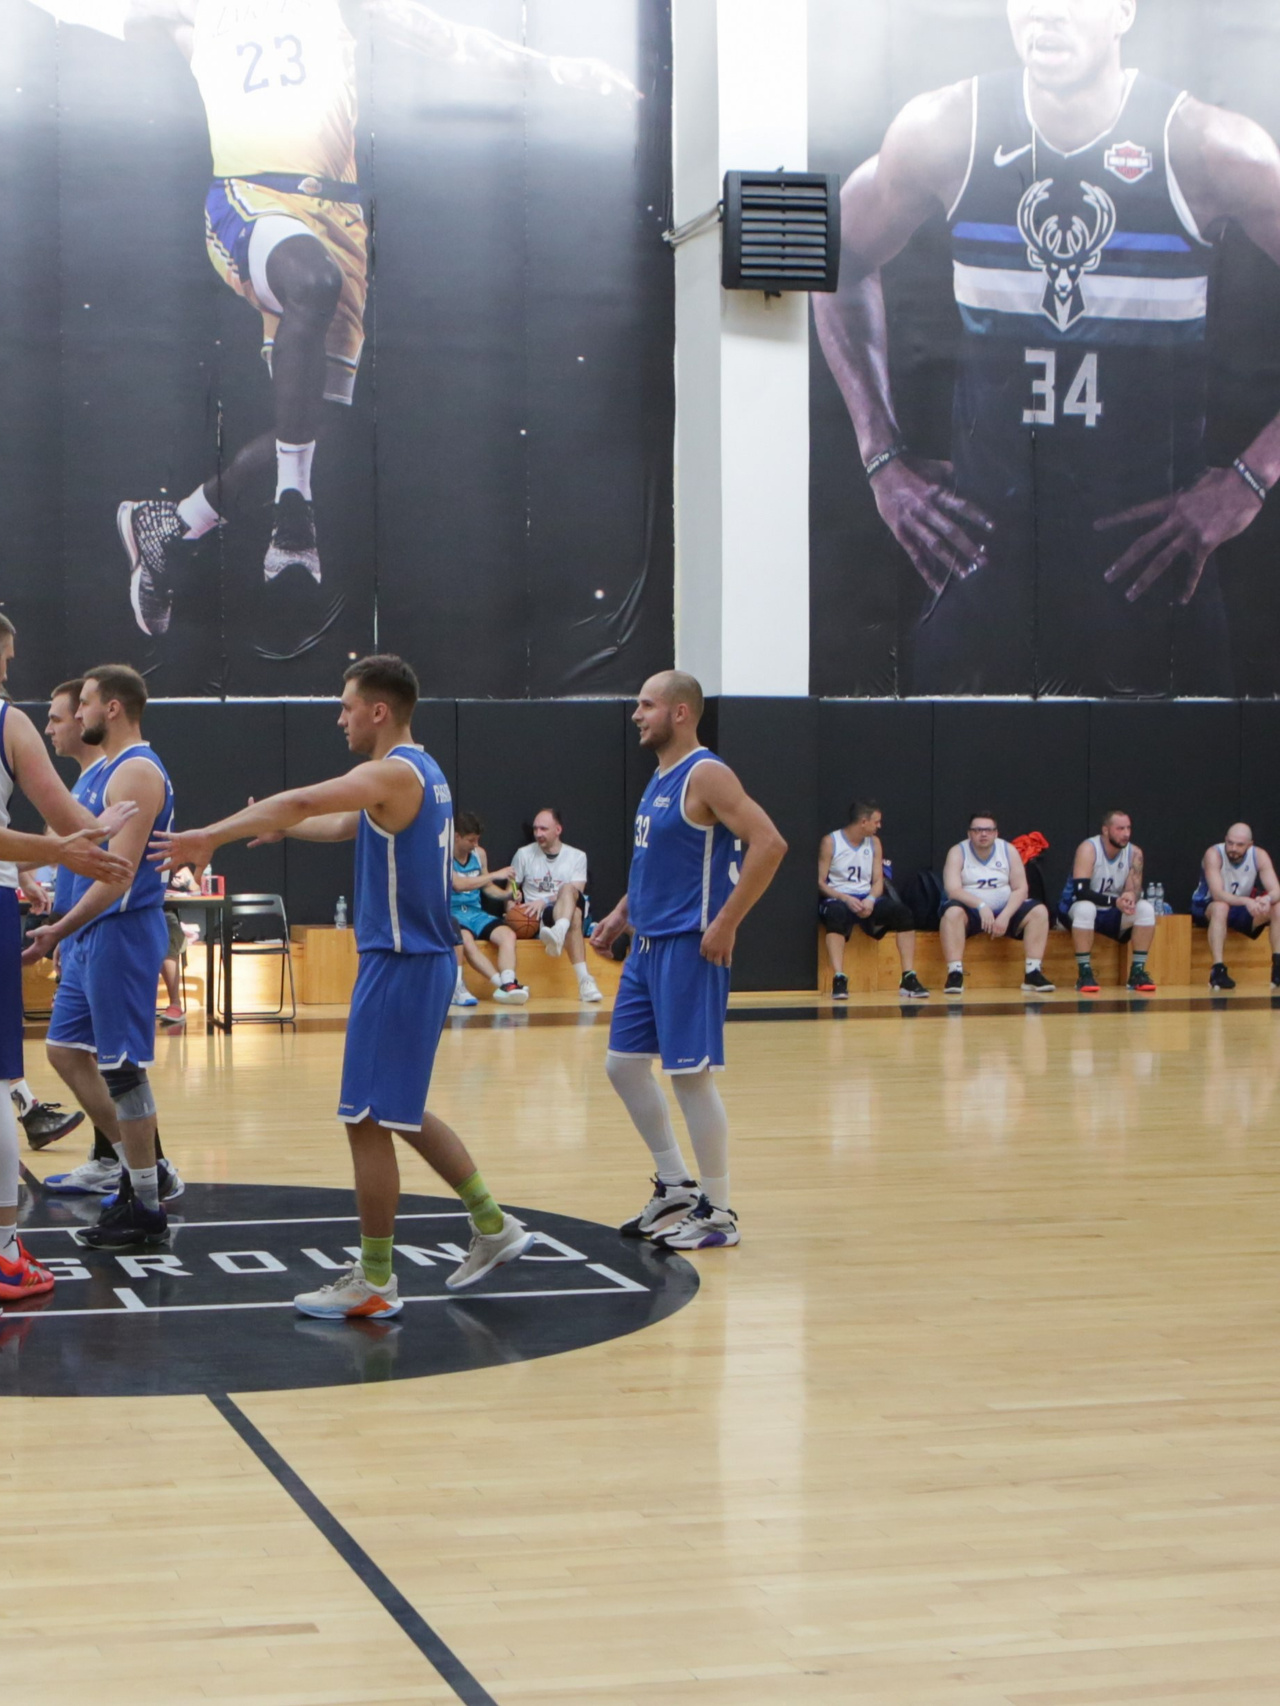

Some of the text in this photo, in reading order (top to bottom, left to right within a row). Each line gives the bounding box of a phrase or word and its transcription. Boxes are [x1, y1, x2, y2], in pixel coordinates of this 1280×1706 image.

[236, 34, 306, 94] 23
[1023, 349, 1103, 427] 34
[634, 814, 651, 848] 32
[847, 865, 862, 882] 21
